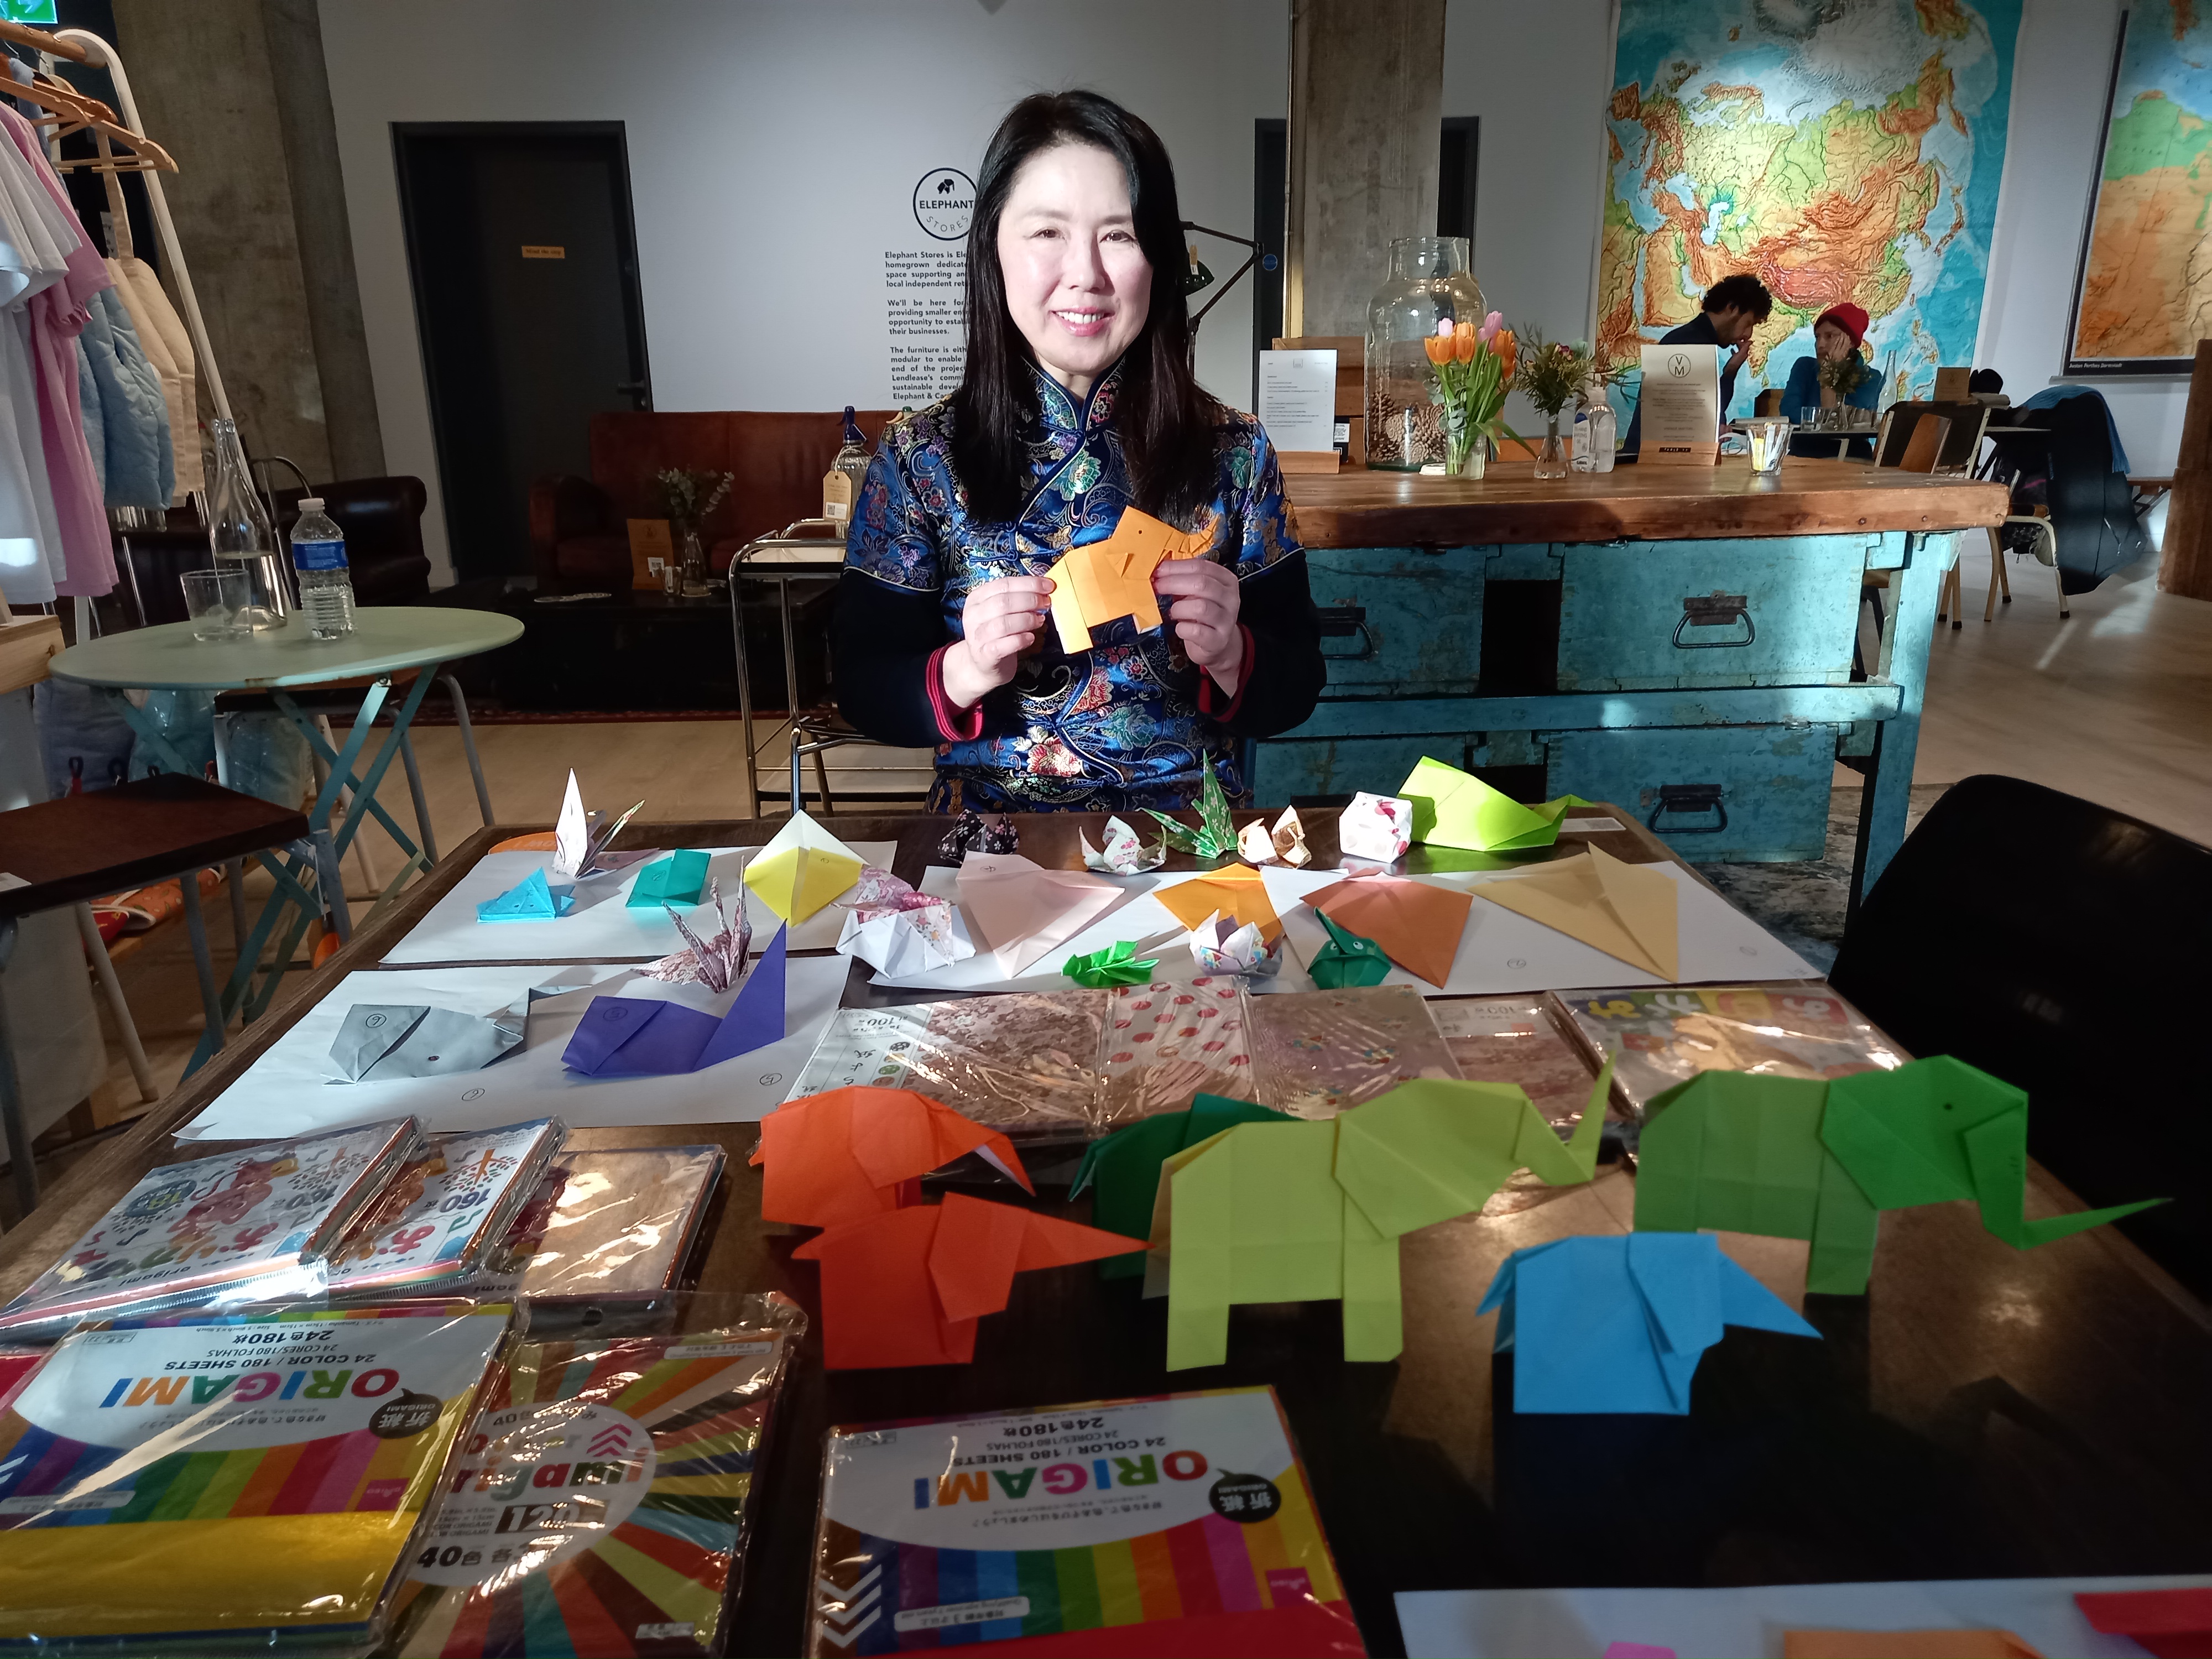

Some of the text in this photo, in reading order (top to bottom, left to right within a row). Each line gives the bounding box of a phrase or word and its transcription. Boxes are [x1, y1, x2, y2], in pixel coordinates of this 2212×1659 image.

[919, 200, 974, 209] ELEPHANT
[926, 215, 968, 232] STORES
[885, 251, 917, 260] Elephant
[885, 260, 930, 269] homegrown
[911, 270, 952, 279] supporting
[905, 280, 952, 289] independent
[888, 309, 923, 317] providing
[889, 318, 932, 327] opportunity
[1676, 356, 1683, 366] V
[1674, 366, 1684, 375] M
[893, 392, 925, 401] Elephant
[118, 1265, 191, 1287] origami
[232, 1329, 335, 1344] 24色180枚
[206, 1348, 255, 1358] FOLHAS
[256, 1344, 321, 1355] CORES/180
[242, 1358, 272, 1368] 180
[287, 1354, 349, 1365] COLOR
[354, 1354, 377, 1363] 24
[164, 1359, 237, 1370] SHEETS
[98, 1368, 400, 1409] ORIGAMI
[986, 1430, 1119, 1451] 24 CORES/180 FOLHAS
[1145, 1437, 1166, 1448] 24
[1078, 1440, 1139, 1454] COLOR
[952, 1453, 1024, 1467] SHEETS
[1030, 1449, 1062, 1460] 180
[450, 1447, 649, 1501] rigami
[914, 1450, 1208, 1510] ORIGAMI
